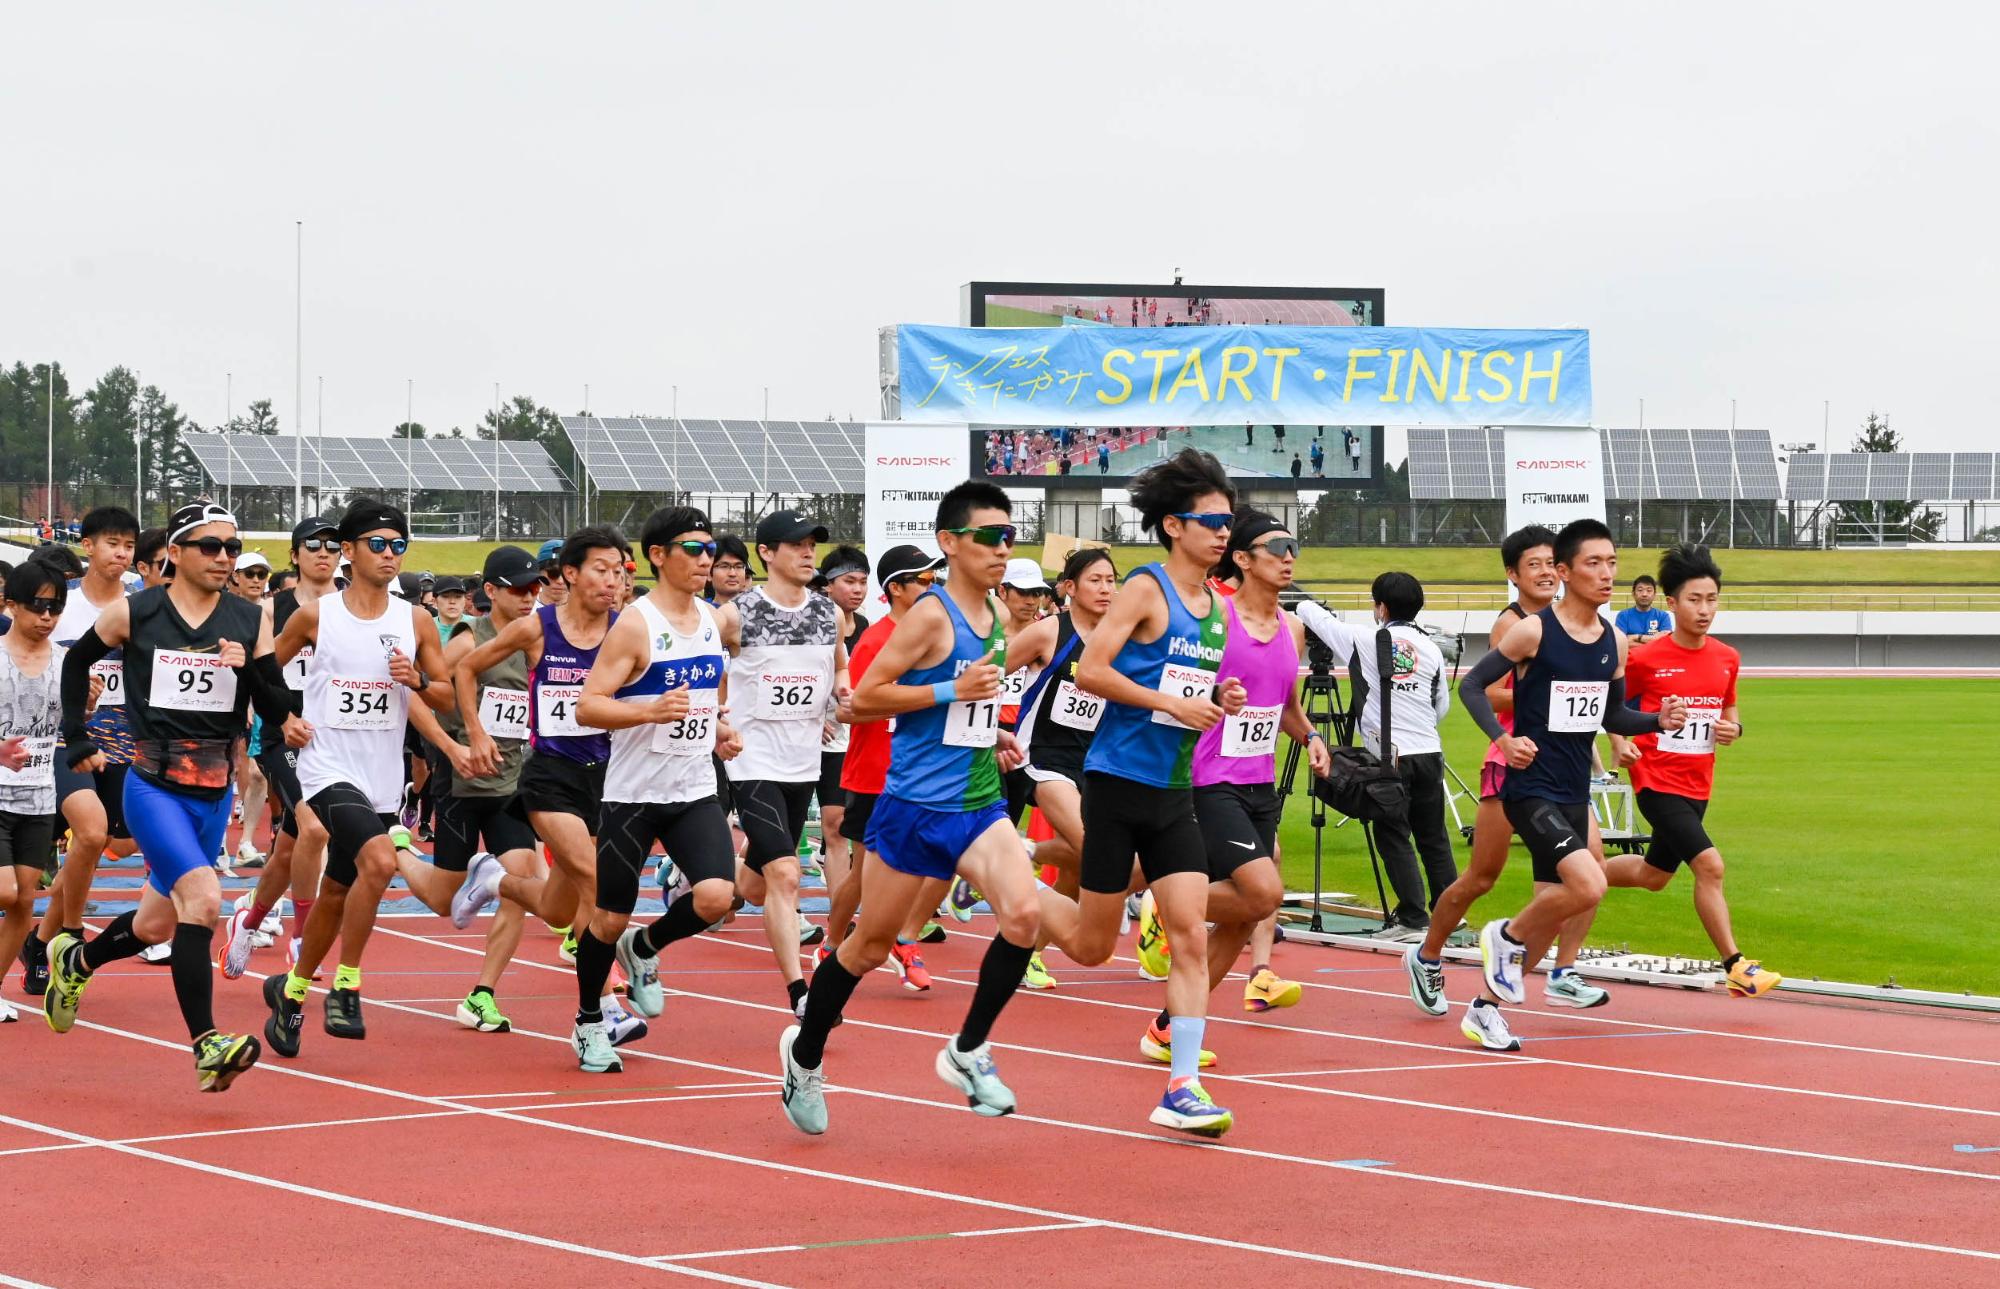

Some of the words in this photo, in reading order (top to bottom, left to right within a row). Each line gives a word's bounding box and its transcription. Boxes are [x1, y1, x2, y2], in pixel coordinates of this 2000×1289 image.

[916, 345, 1050, 408] ランフェス
[1096, 347, 1300, 404] START
[1342, 348, 1563, 404] FINISH
[877, 457, 951, 466] SANDISK
[1516, 460, 1587, 469] SANDISK
[897, 521, 936, 531] 千田工務
[178, 669, 214, 694] 95
[331, 679, 394, 690] SANDISK
[664, 663, 716, 686] きたかみ
[763, 674, 818, 683] SANDISK
[542, 690, 581, 698] SAND
[770, 685, 813, 706] 362
[1555, 685, 1603, 694] SANDISK
[339, 691, 389, 714] 354
[1063, 696, 1098, 719] 380
[1565, 696, 1600, 717] 126
[494, 703, 527, 724] 142
[668, 718, 709, 740] 385
[1239, 721, 1274, 742] 182
[1671, 721, 1711, 741] 211
